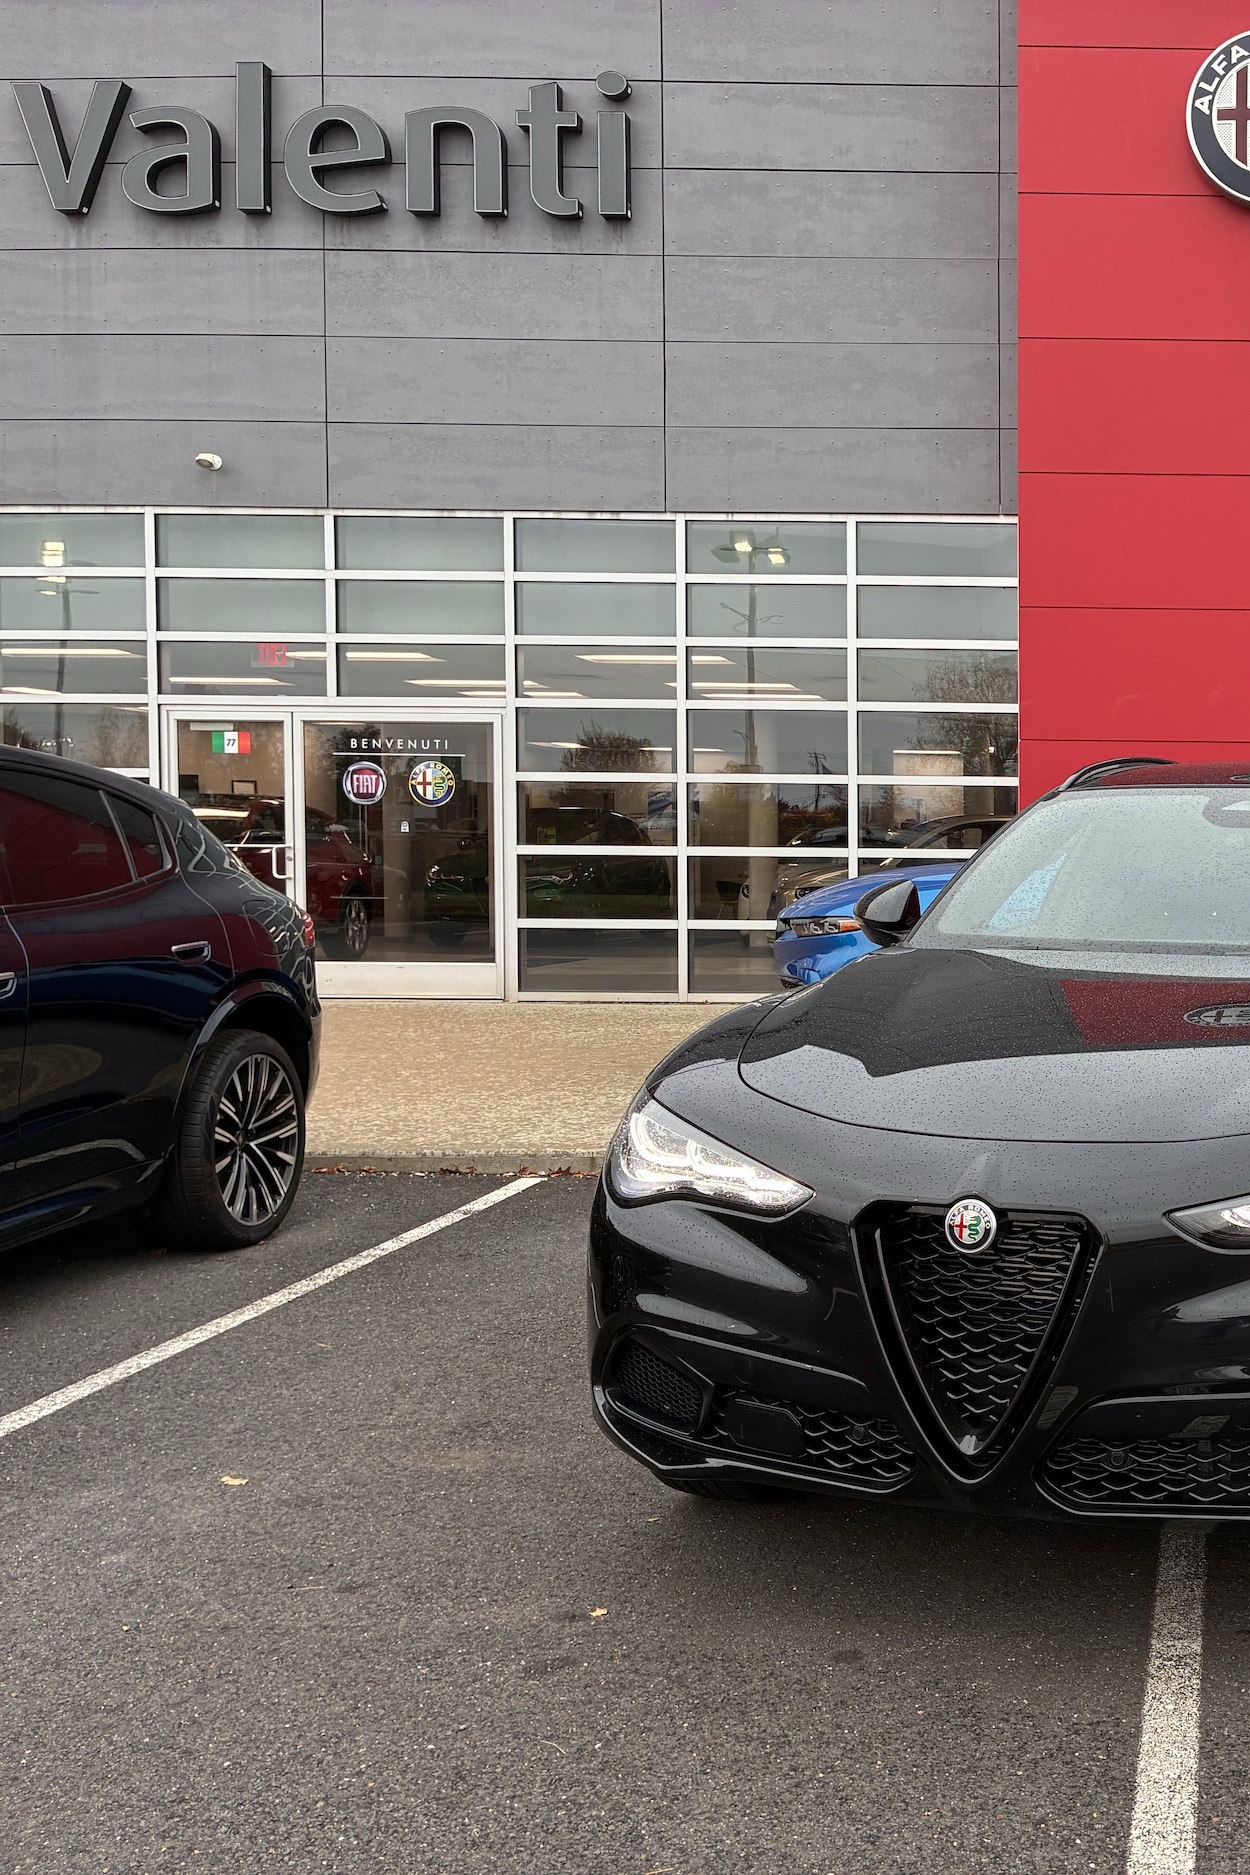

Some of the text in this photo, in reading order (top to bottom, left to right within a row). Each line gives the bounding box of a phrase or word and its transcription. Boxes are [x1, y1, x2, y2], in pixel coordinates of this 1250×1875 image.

[1194, 44, 1250, 116] ALFA
[10, 61, 632, 218] Valenti
[226, 738, 236, 747] 77
[350, 738, 448, 750] BENVENUTI
[353, 774, 378, 794] FIAT
[429, 762, 454, 787] ROMEO
[967, 1204, 992, 1230] ROMEO
